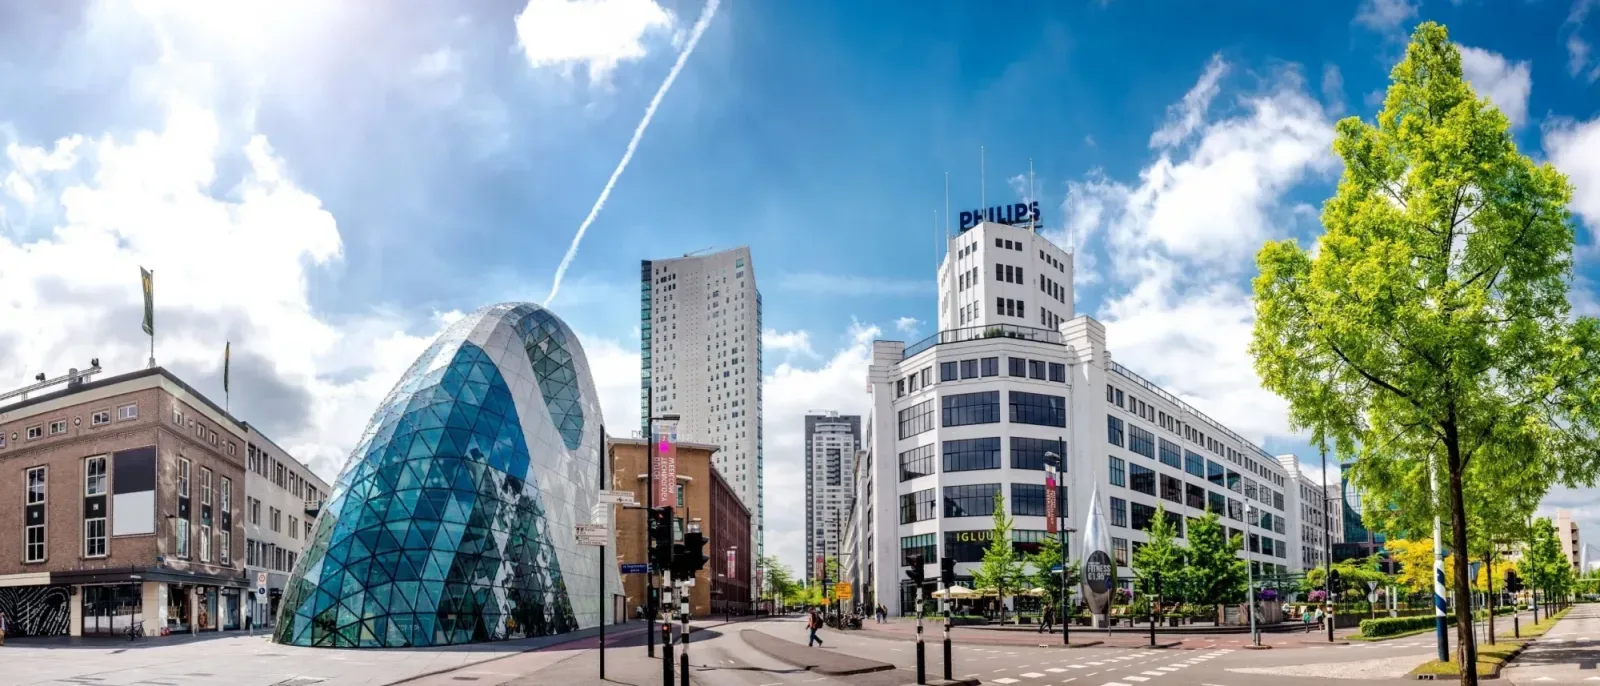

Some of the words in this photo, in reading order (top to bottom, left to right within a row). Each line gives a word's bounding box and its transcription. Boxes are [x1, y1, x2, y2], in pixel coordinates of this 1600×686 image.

[960, 201, 1040, 231] PHILIPS
[956, 531, 994, 541] IGLUU
[1088, 565, 1111, 573] FITNESS
